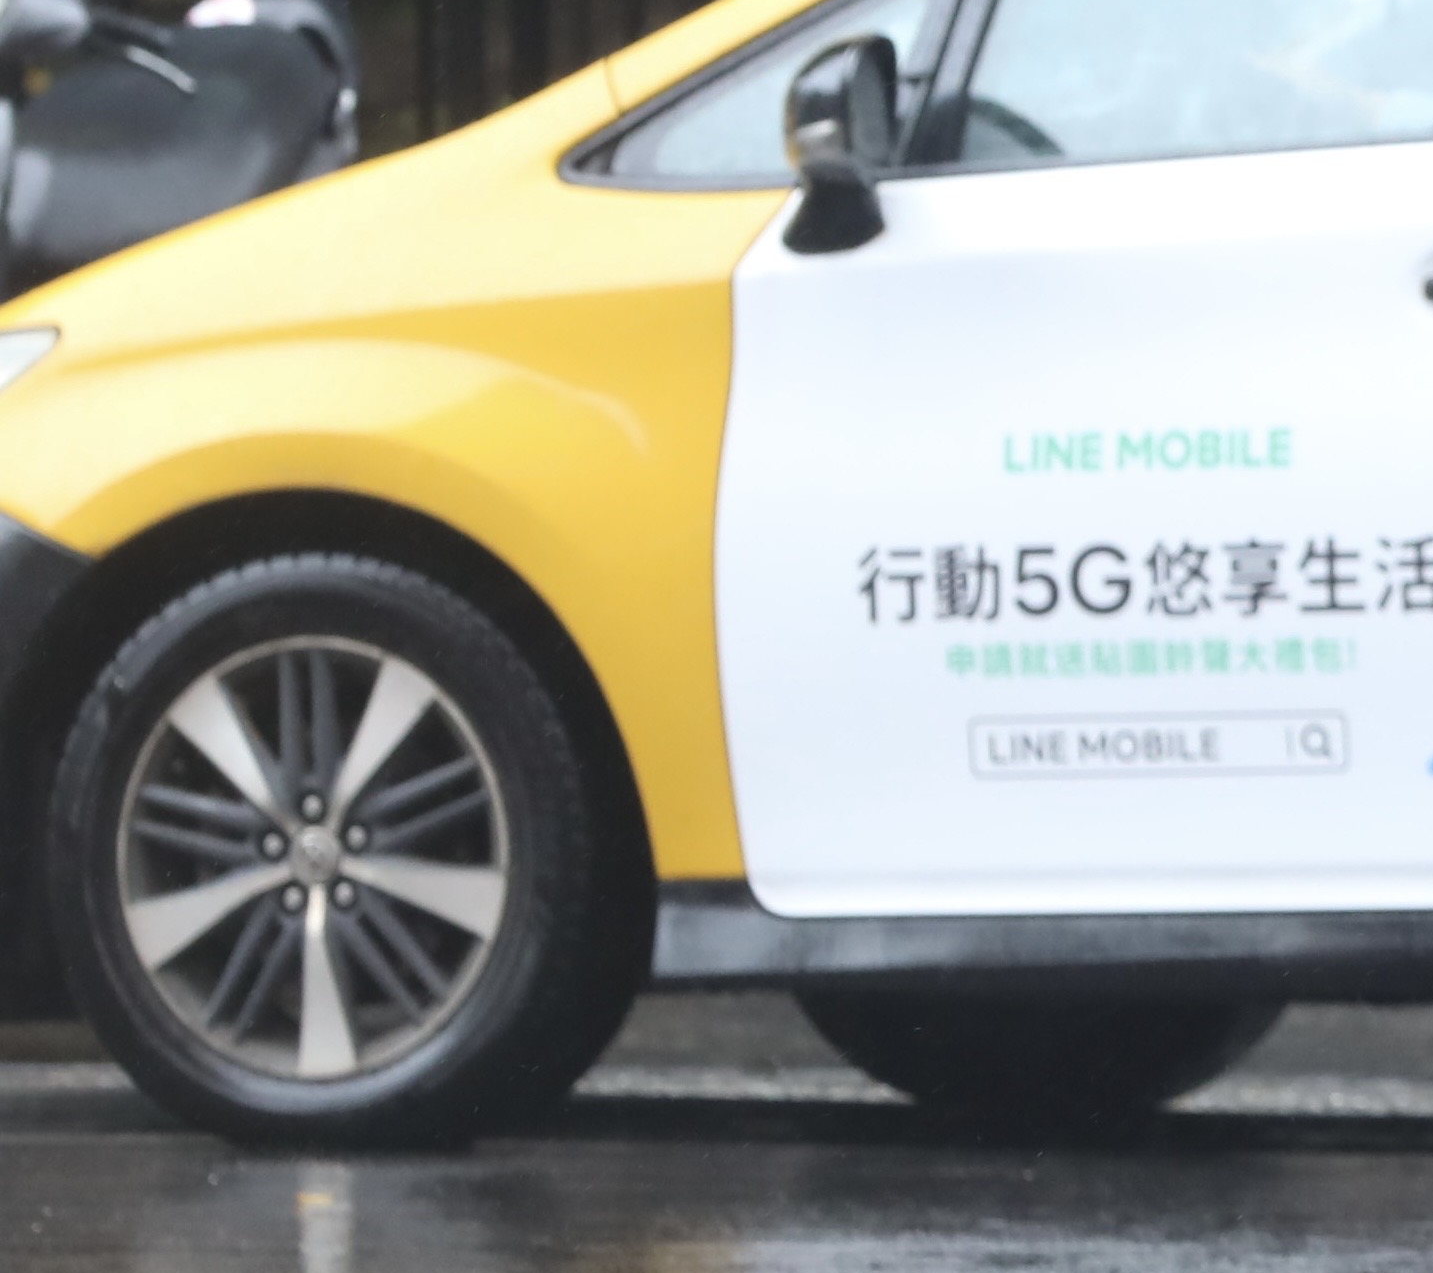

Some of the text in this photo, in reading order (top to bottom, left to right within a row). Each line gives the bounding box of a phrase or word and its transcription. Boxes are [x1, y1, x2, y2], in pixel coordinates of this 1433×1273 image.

[1003, 427, 1292, 472] LINE MOBILE
[987, 726, 1222, 766] LINE MOBILE
